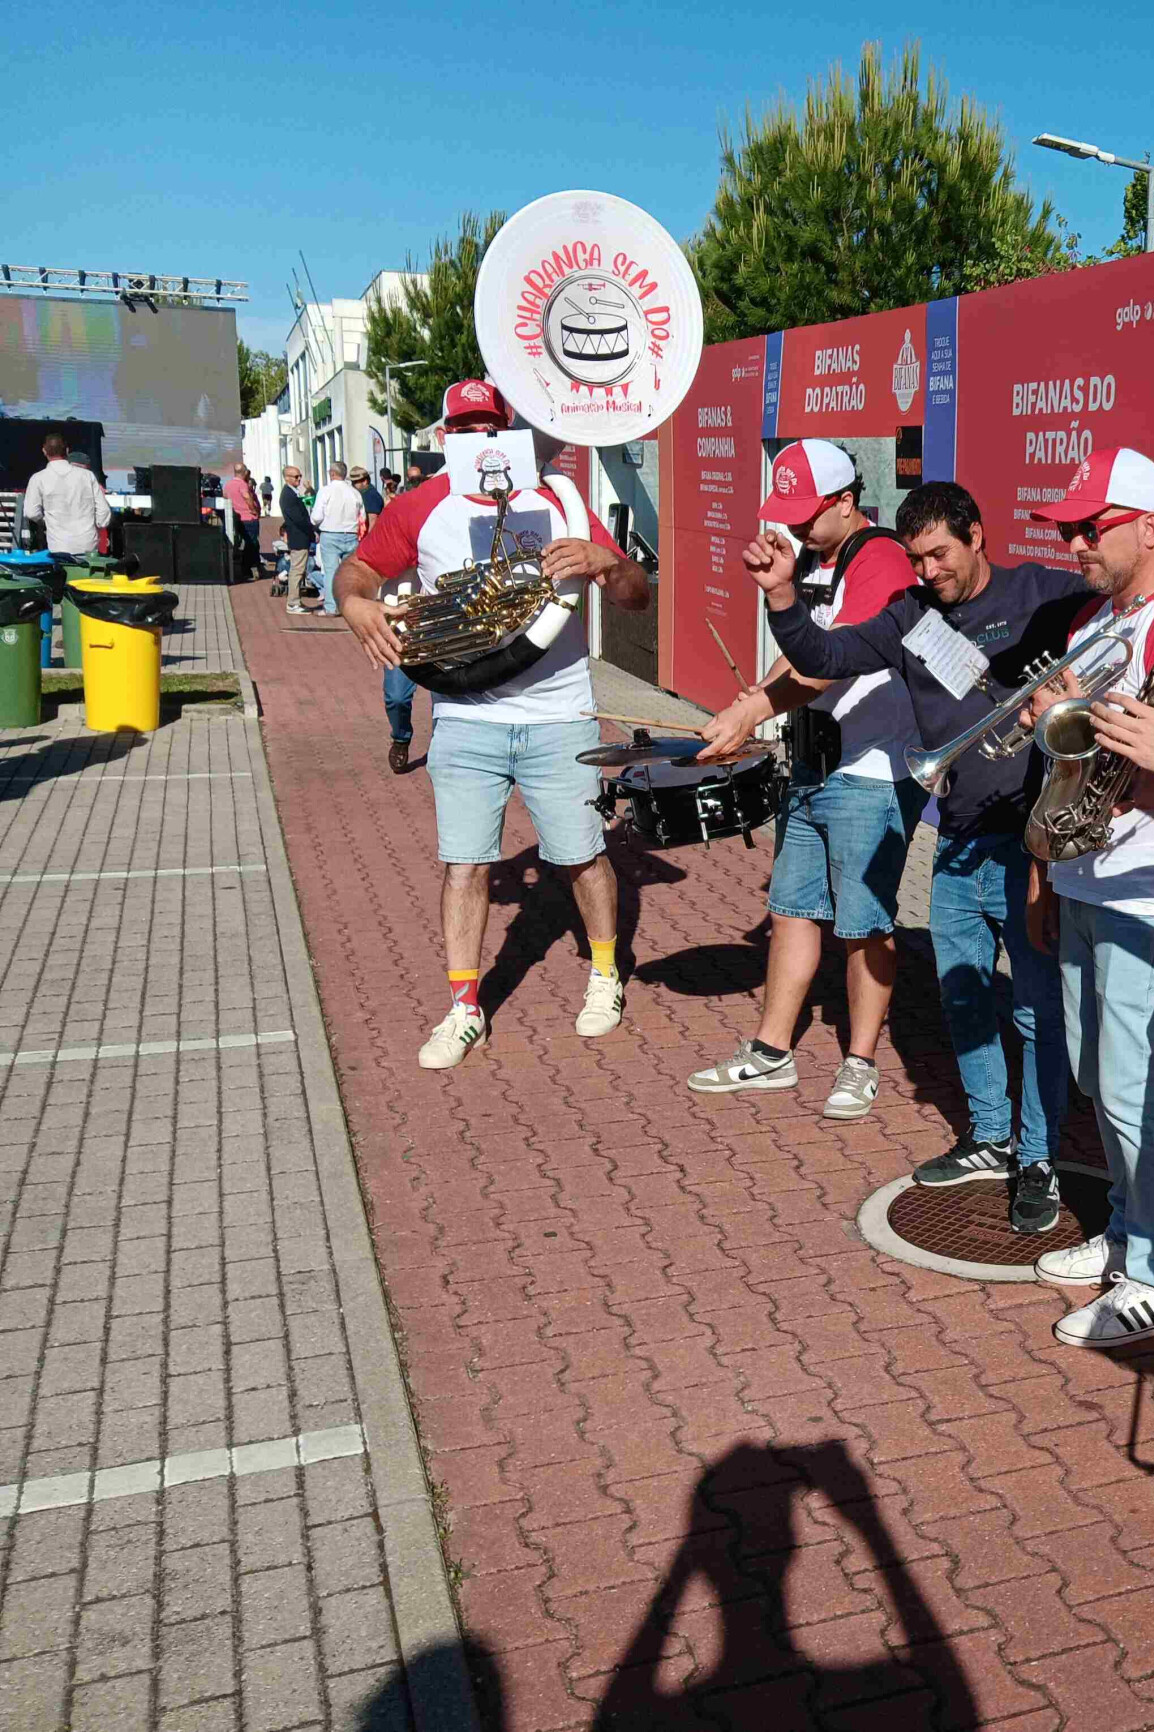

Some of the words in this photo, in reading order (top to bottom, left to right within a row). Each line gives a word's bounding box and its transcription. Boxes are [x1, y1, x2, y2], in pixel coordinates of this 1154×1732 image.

[612, 252, 658, 300] SEM
[1116, 298, 1141, 331] galp
[814, 343, 860, 376] BIFANAS
[929, 374, 954, 391] BIFANA
[804, 388, 821, 413] DO
[822, 377, 865, 412] PATRÃO
[1012, 377, 1085, 416] BIFANAS
[1088, 374, 1116, 412] DO
[606, 399, 642, 413] Musical
[698, 406, 725, 428] BIFANAS
[726, 405, 732, 427] &
[697, 437, 735, 458] COMPANHIA
[1025, 420, 1093, 465] PATRÃO
[1017, 487, 1041, 502] BIFANA
[1042, 487, 1067, 503] ORIGIN
[1013, 508, 1031, 520] BIFAN
[1025, 527, 1043, 540] BIFANA
[1034, 544, 1055, 559] PATRÃO
[976, 629, 1010, 644] CLUB
